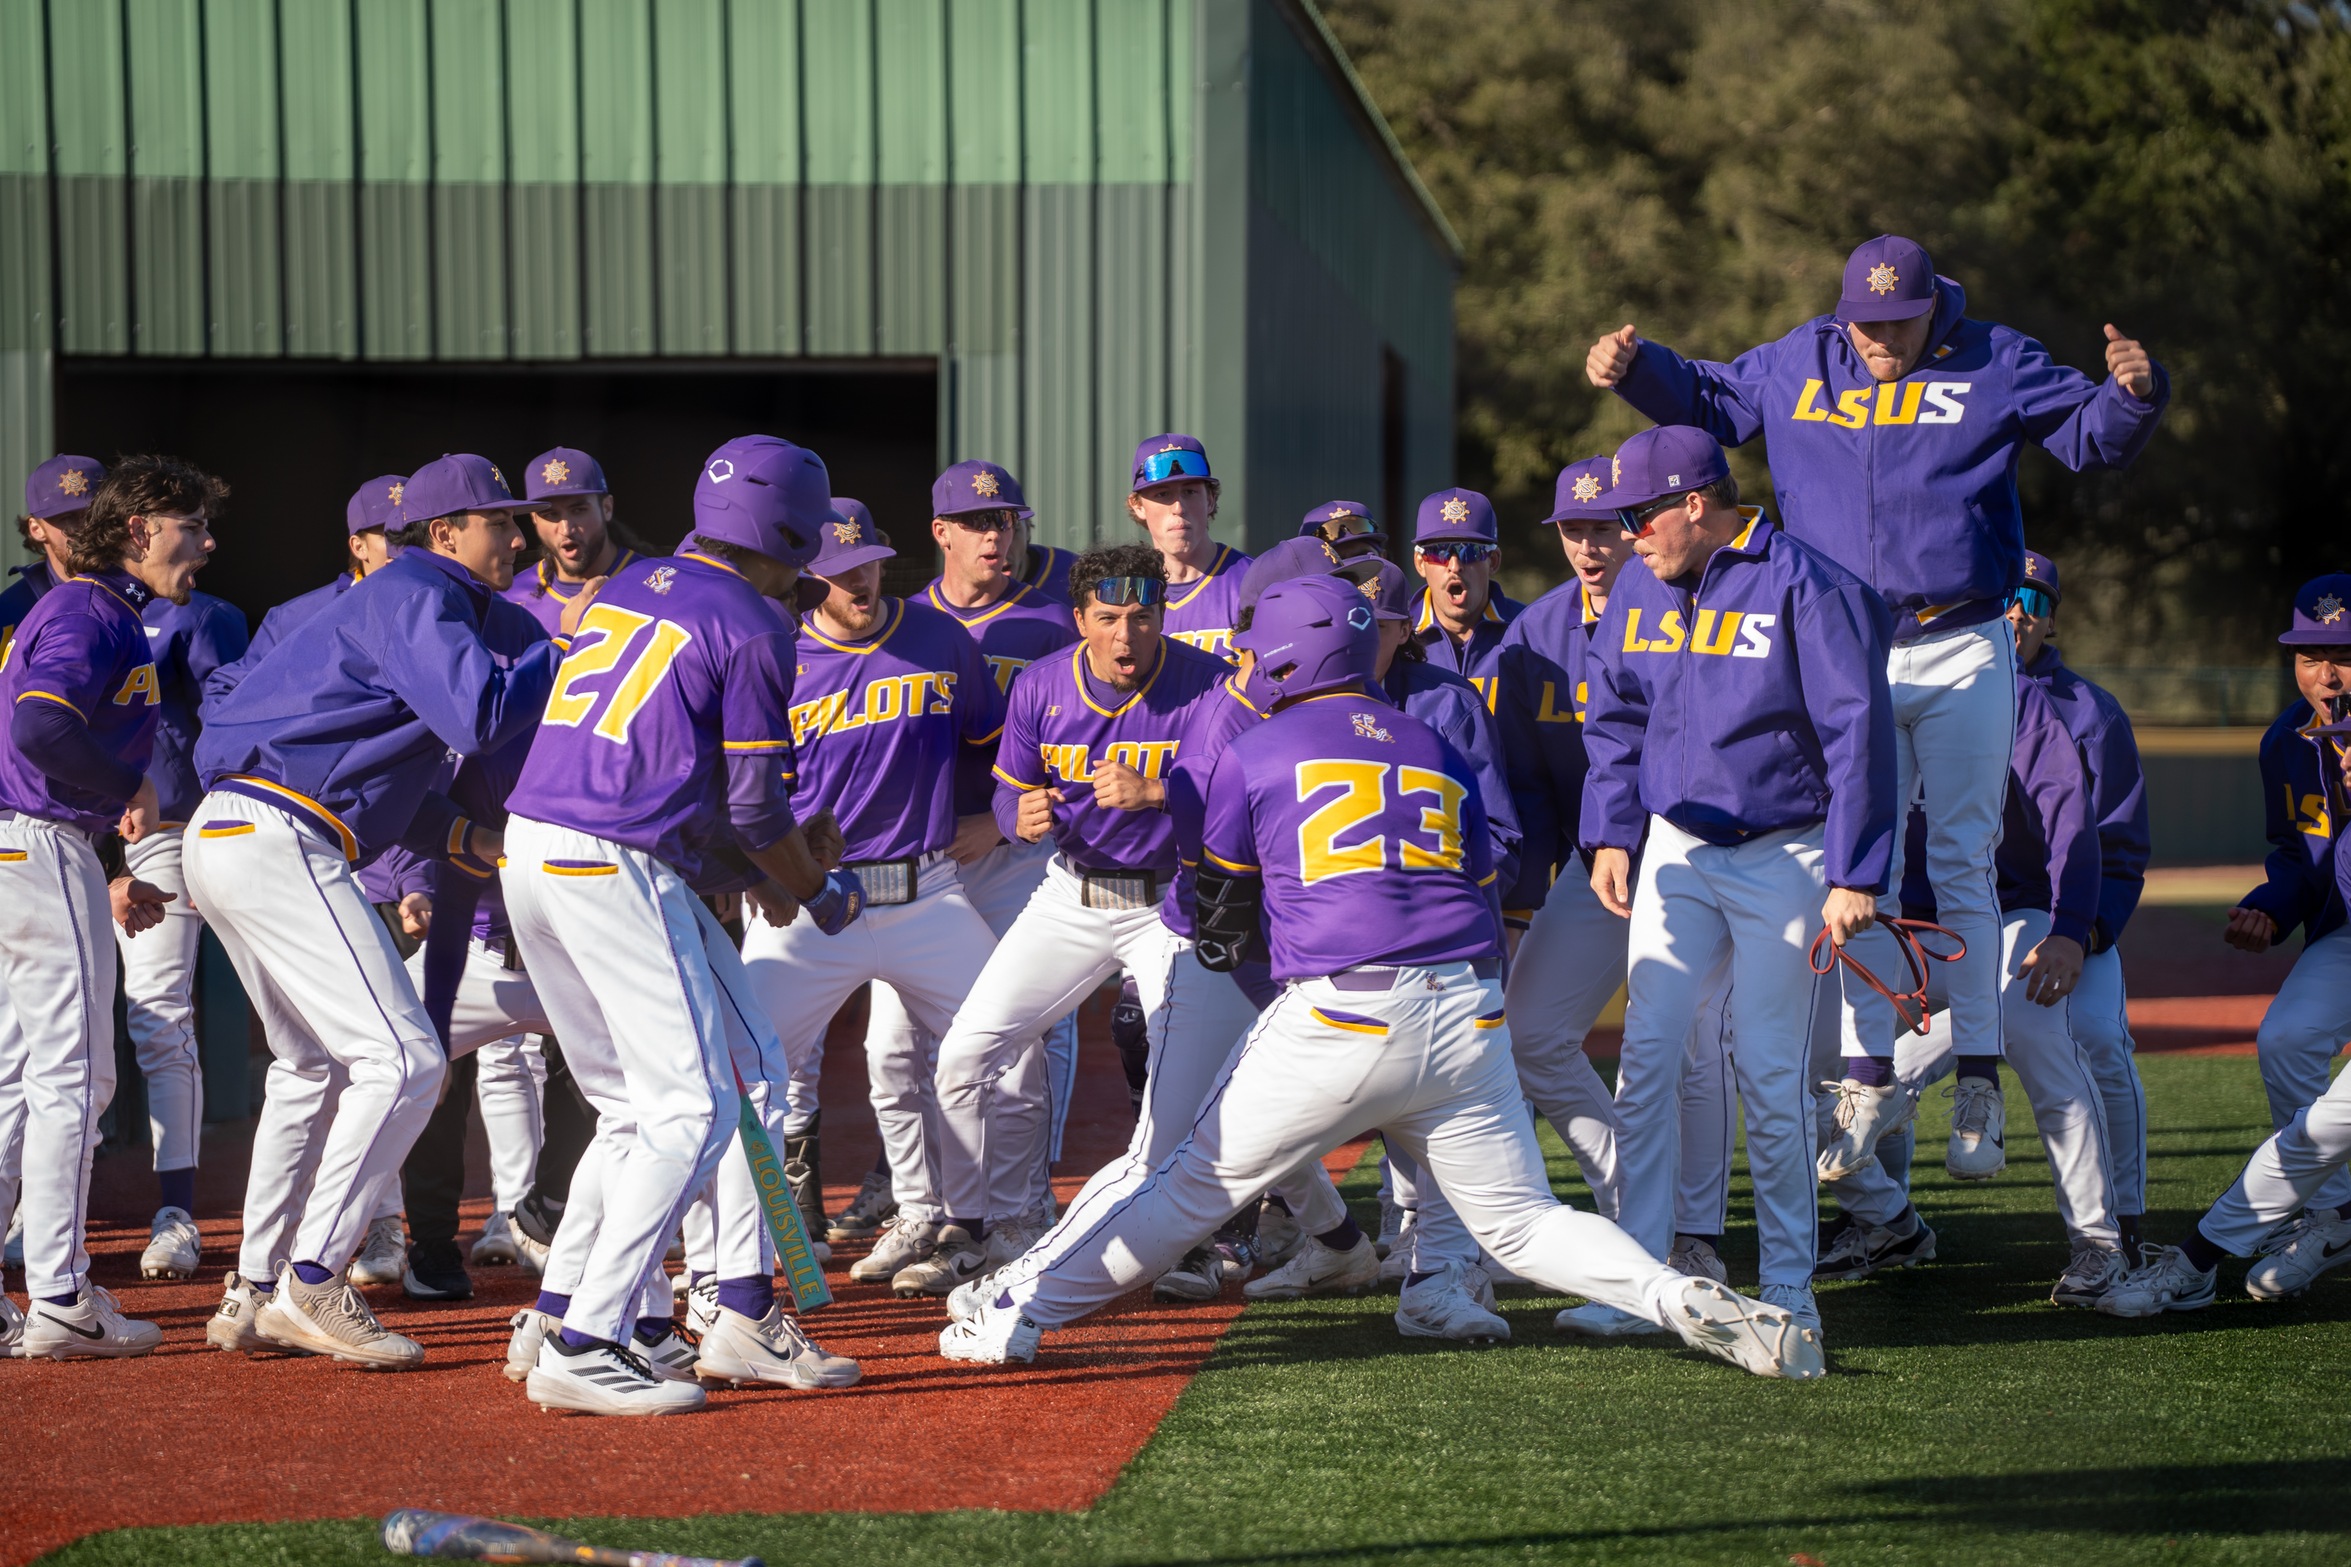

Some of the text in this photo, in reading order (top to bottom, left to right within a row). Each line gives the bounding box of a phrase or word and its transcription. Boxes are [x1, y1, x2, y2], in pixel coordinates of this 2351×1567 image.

[1791, 378, 1972, 429] LSUS
[1622, 608, 1777, 659] LSUS
[112, 661, 161, 706] PI
[542, 602, 693, 746] 21
[788, 671, 958, 746] PILOTS
[1039, 739, 1181, 783] PILOT
[1295, 758, 1469, 887] 23
[752, 1152, 821, 1301] LOUISVILLE
